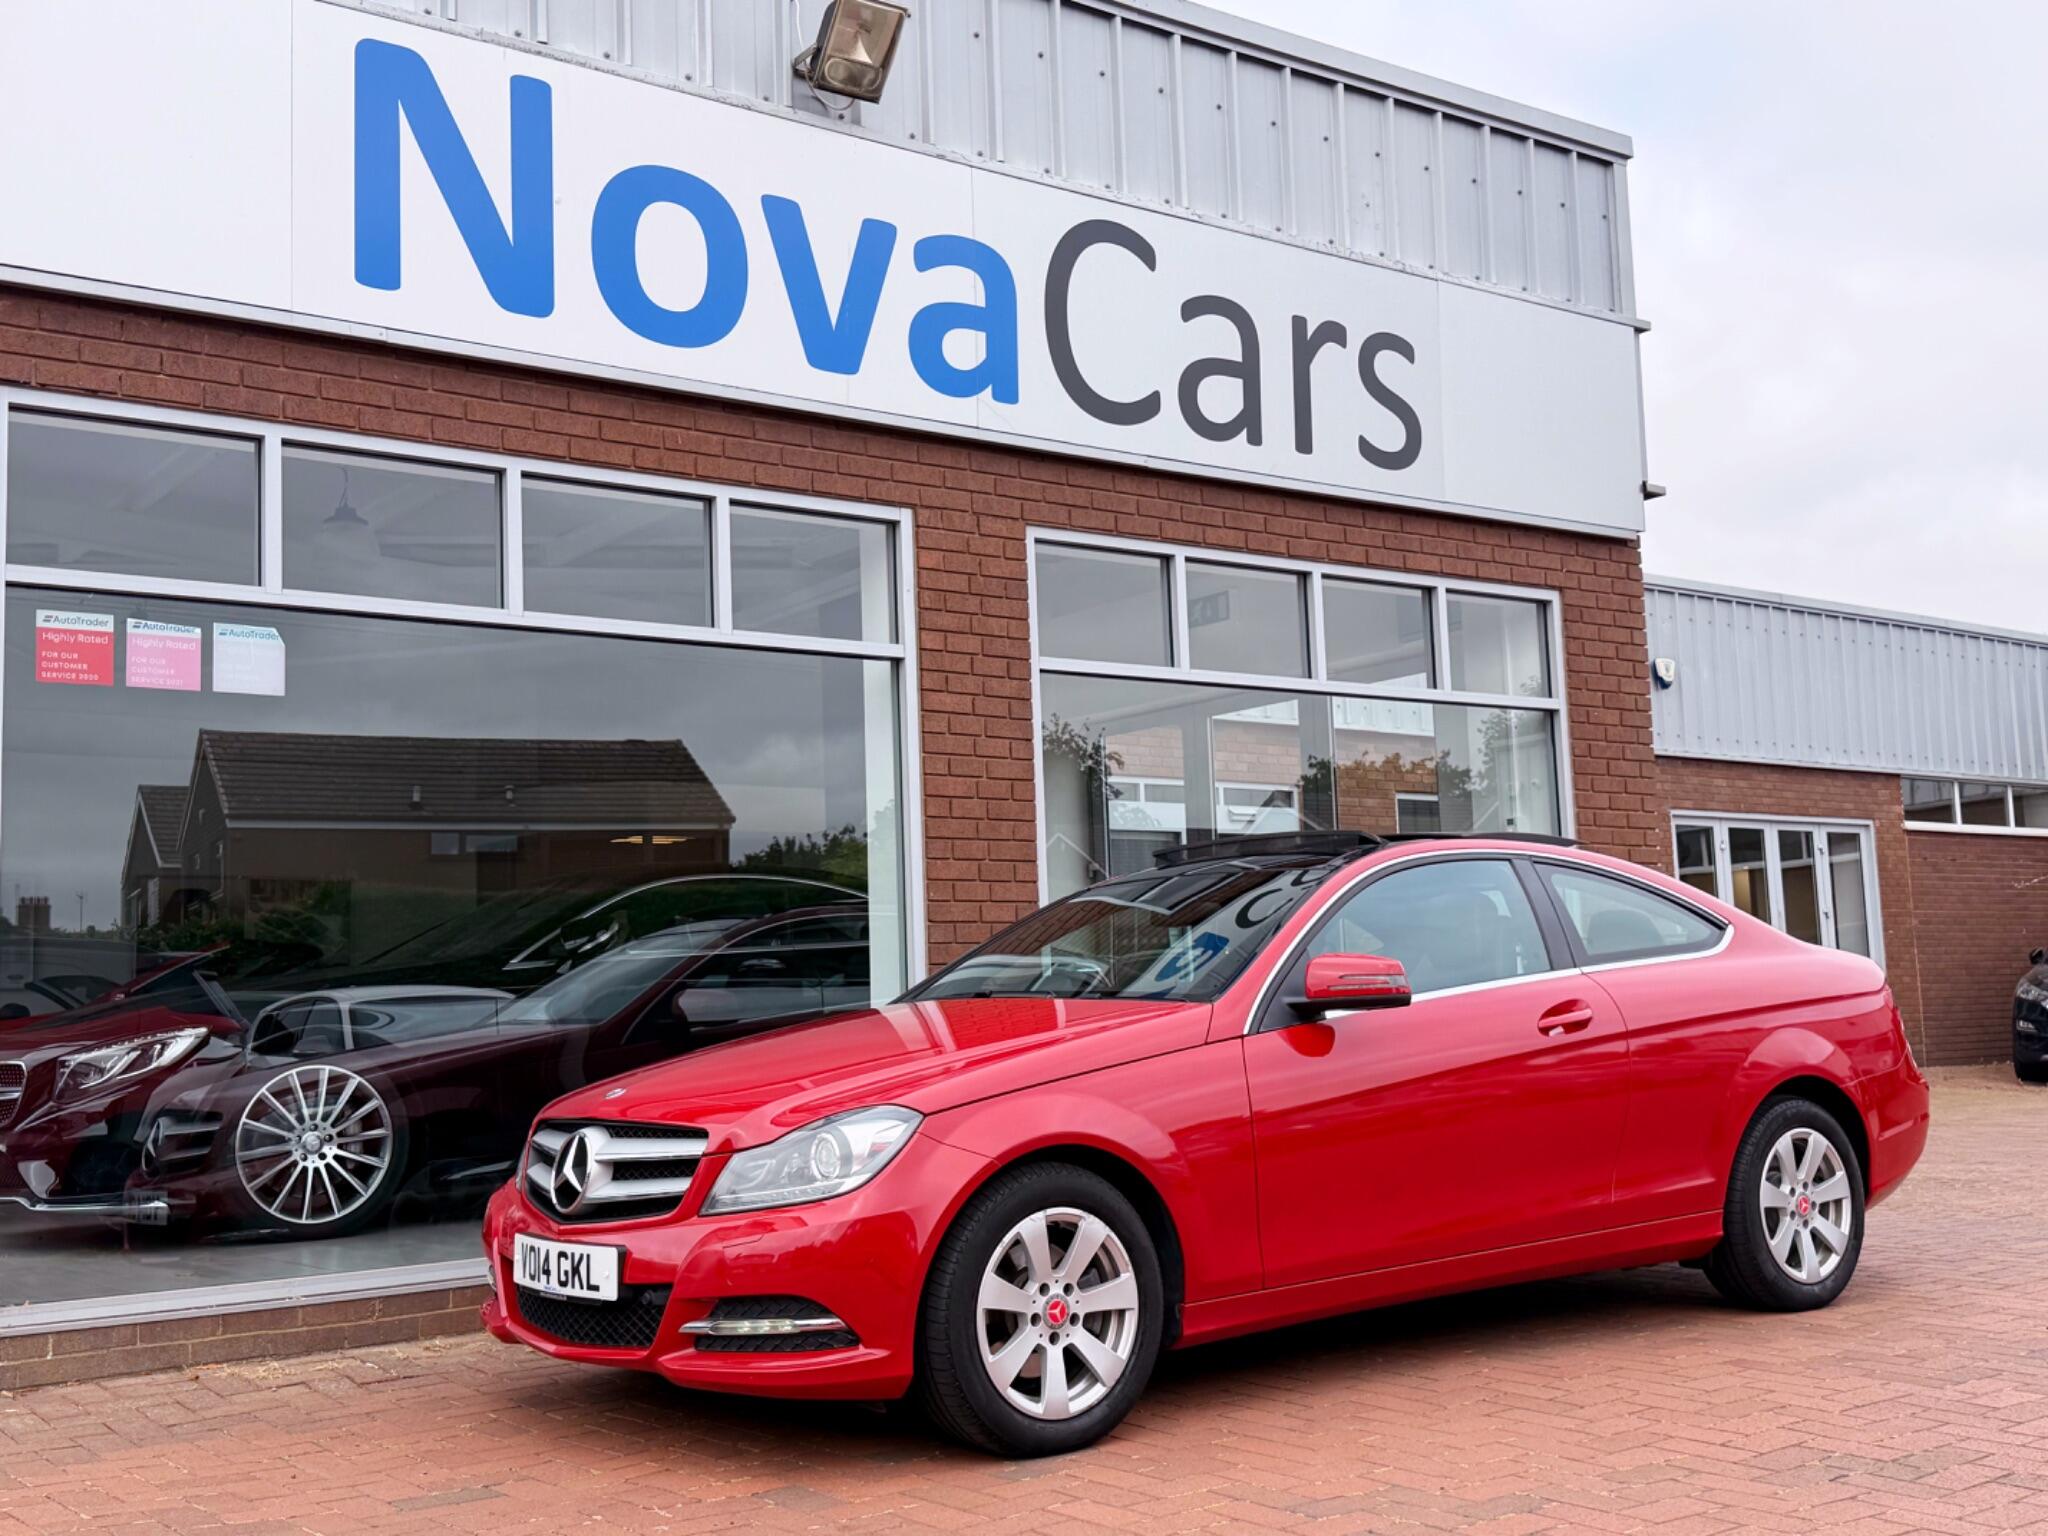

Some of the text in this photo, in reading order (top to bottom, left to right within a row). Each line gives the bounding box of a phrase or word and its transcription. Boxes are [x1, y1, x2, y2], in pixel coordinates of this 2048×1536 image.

[53, 615, 109, 627] AutoTrader
[42, 632, 109, 645] Highly Rated
[131, 637, 196, 651] Highly Rated
[41, 650, 79, 660] FOR OUR
[41, 661, 88, 671] CUSTOMER
[41, 671, 77, 680] SERVICE
[557, 1250, 600, 1293] GKL
